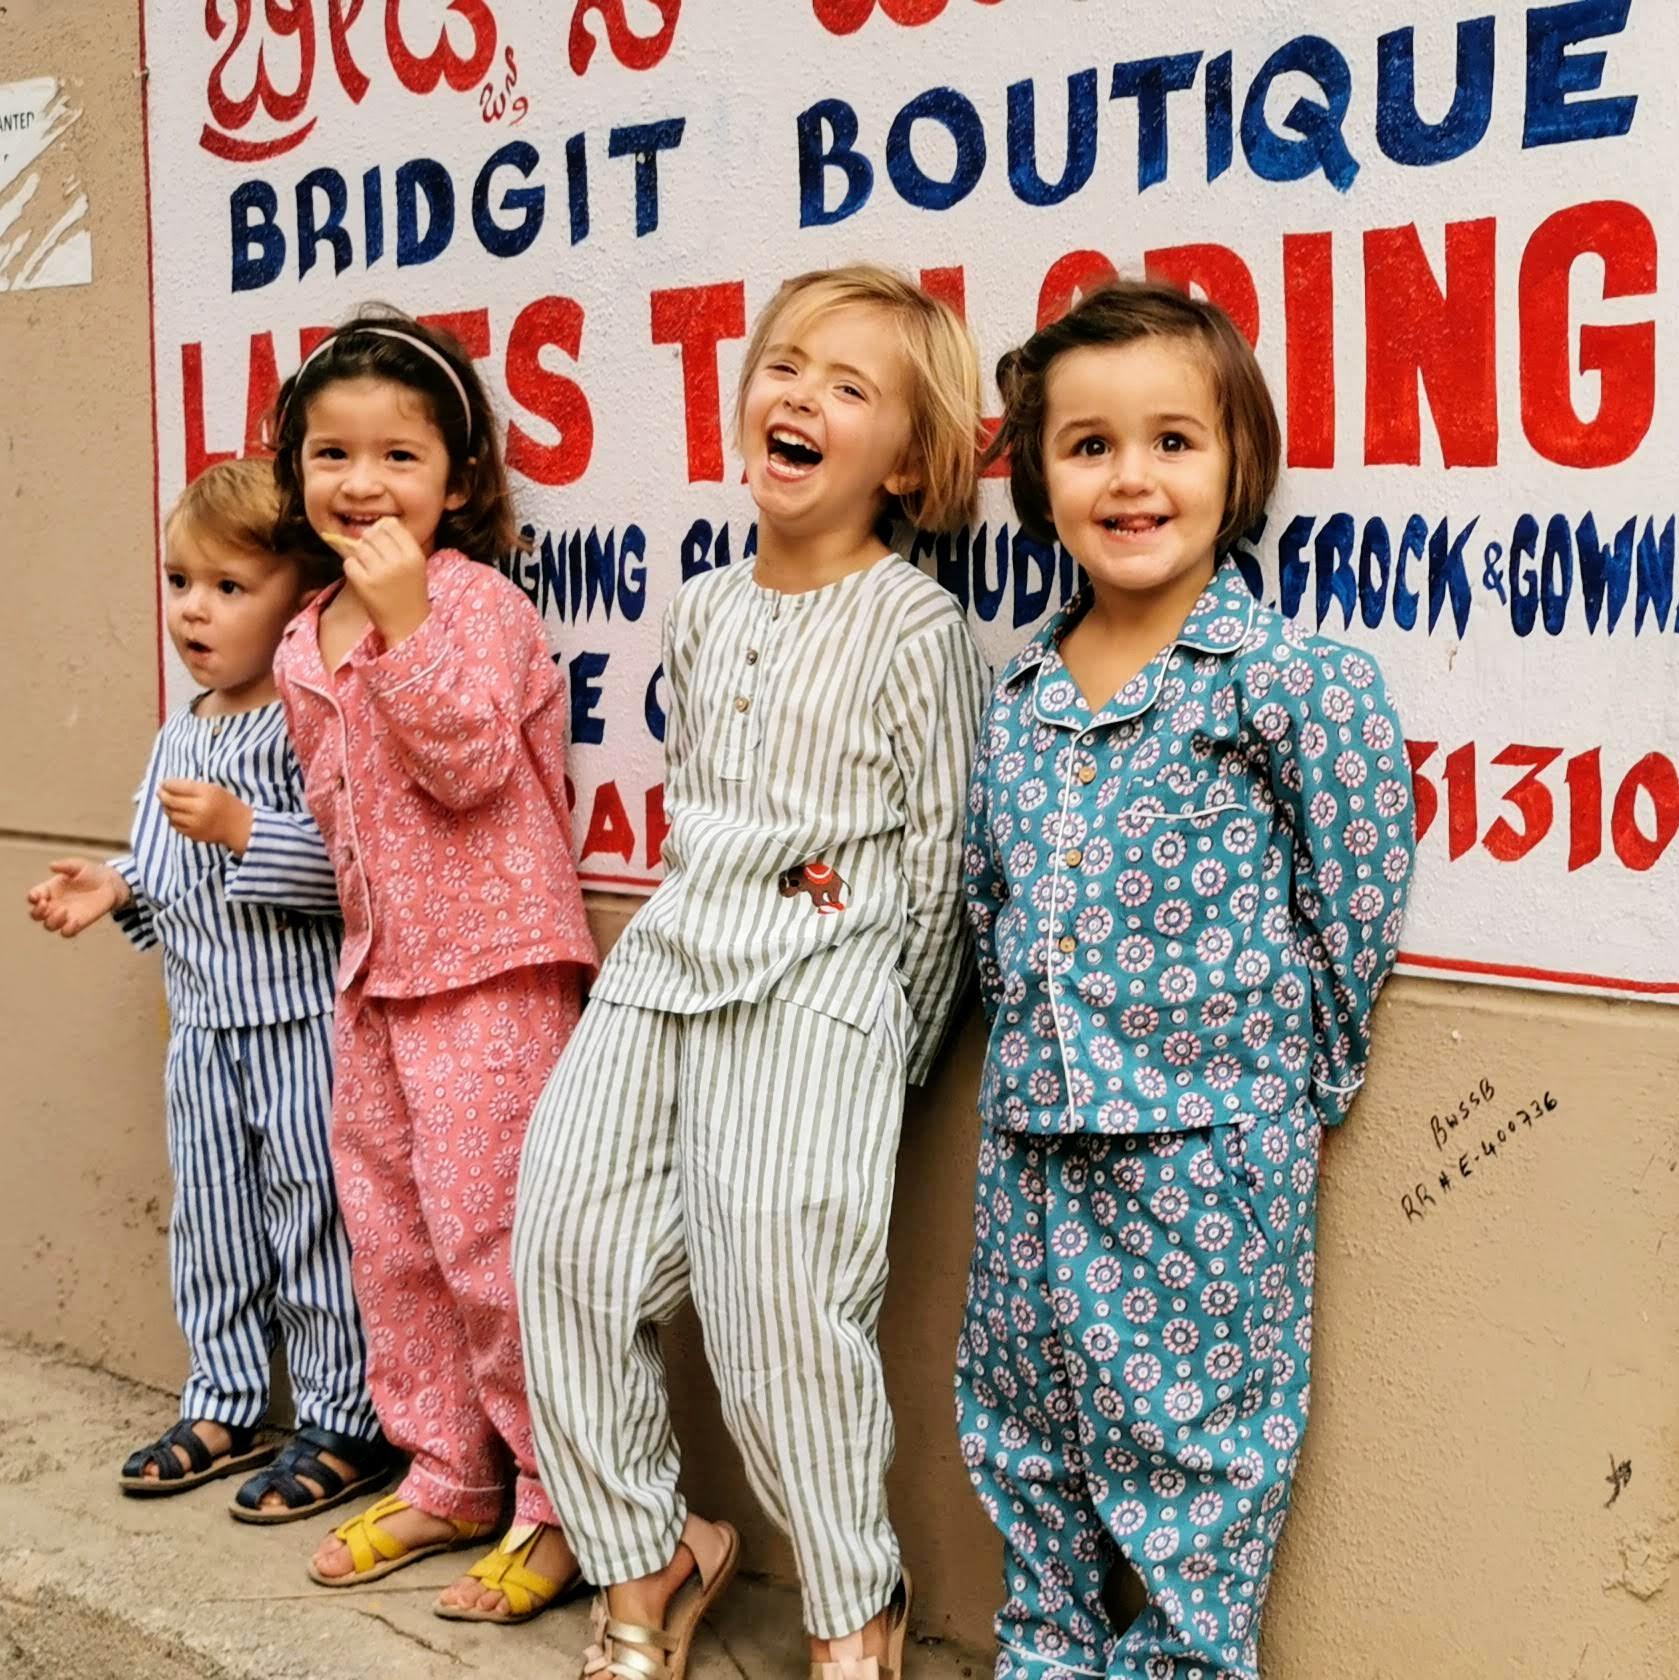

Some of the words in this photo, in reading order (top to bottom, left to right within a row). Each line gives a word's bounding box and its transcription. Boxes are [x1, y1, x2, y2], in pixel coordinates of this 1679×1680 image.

[231, 117, 686, 293] BRIDGIT
[798, 0, 1638, 229] BOUTIQUE
[1278, 512, 1481, 640] FROCK
[1483, 541, 1507, 605] &
[1509, 510, 1679, 638] GOWN
